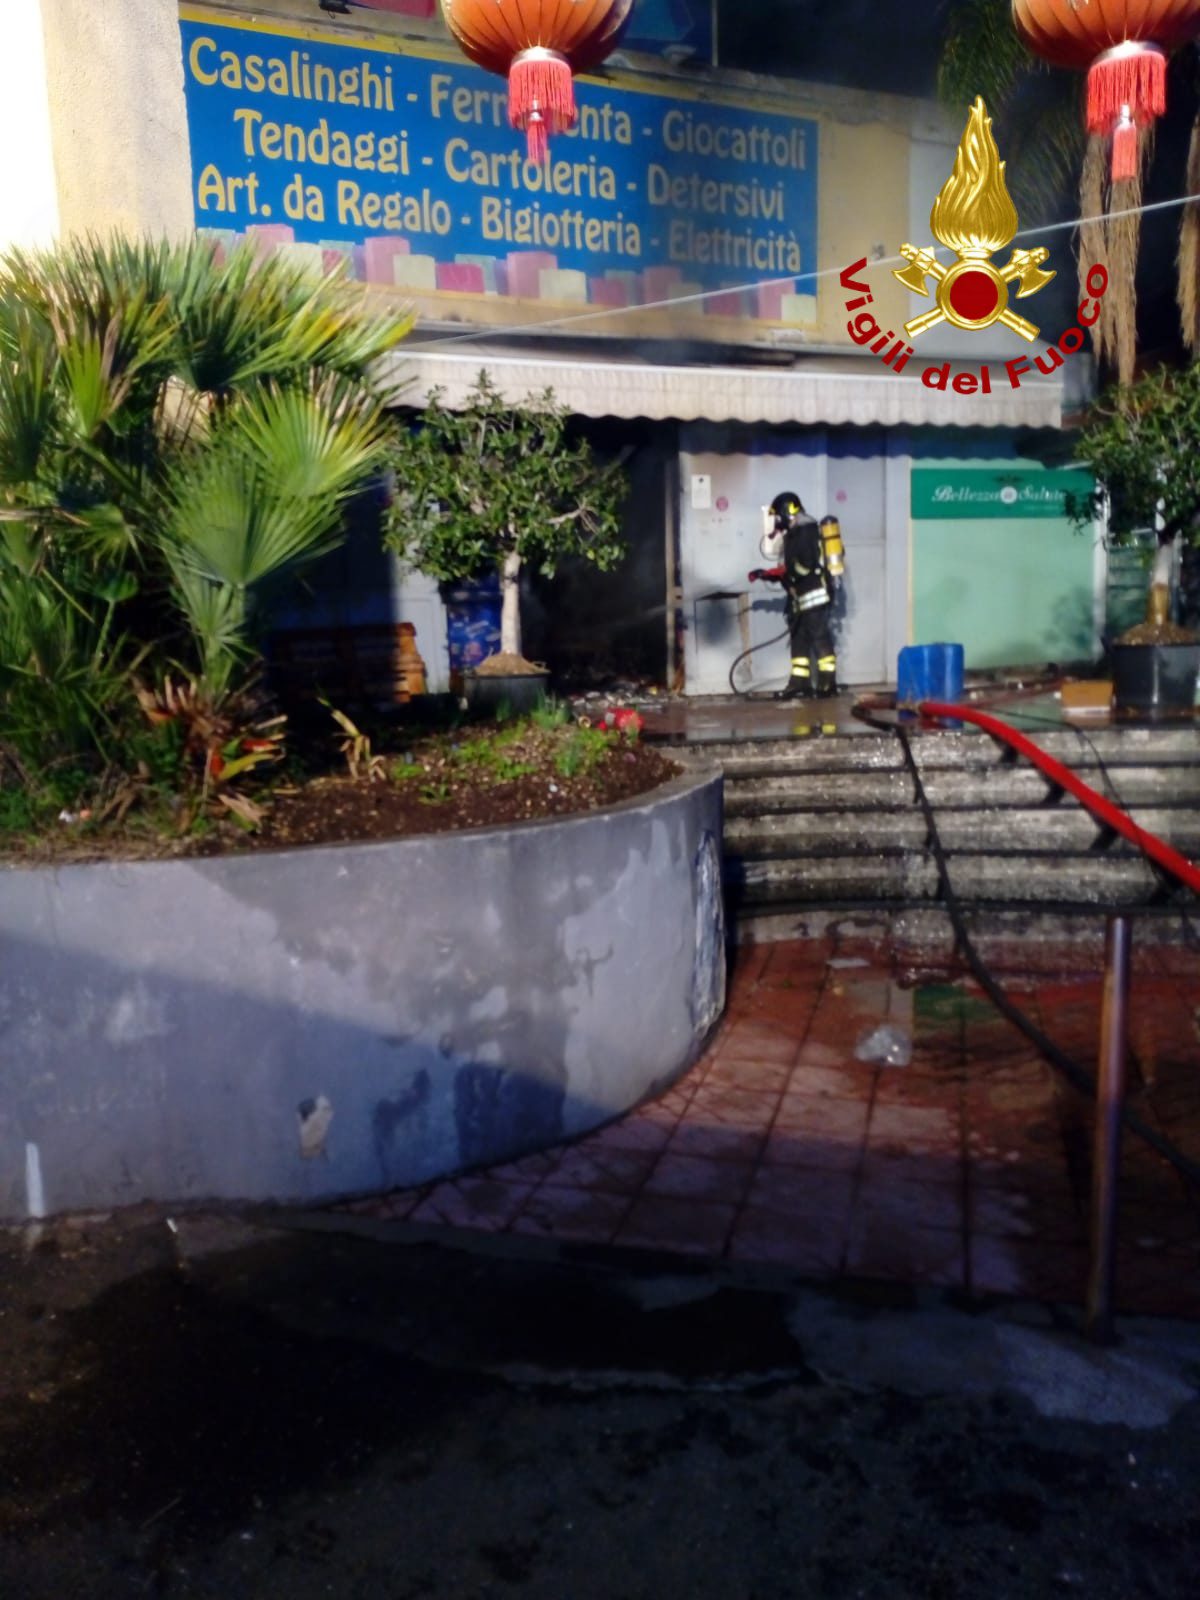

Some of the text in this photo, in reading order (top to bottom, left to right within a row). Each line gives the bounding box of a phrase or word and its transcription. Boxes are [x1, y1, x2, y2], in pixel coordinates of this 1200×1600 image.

[189, 36, 395, 112] Casalinghi
[430, 73, 632, 145] Ferrnta
[662, 109, 807, 170] Giocattoli
[197, 163, 272, 217] Art.
[283, 173, 325, 222] da
[337, 179, 451, 236] Regalo
[481, 195, 642, 256] Bigiotteria
[668, 218, 801, 273] Elettricità
[233, 108, 410, 176] Tendaggi
[444, 137, 616, 200] Cartoleria
[647, 162, 785, 222] Detersivi
